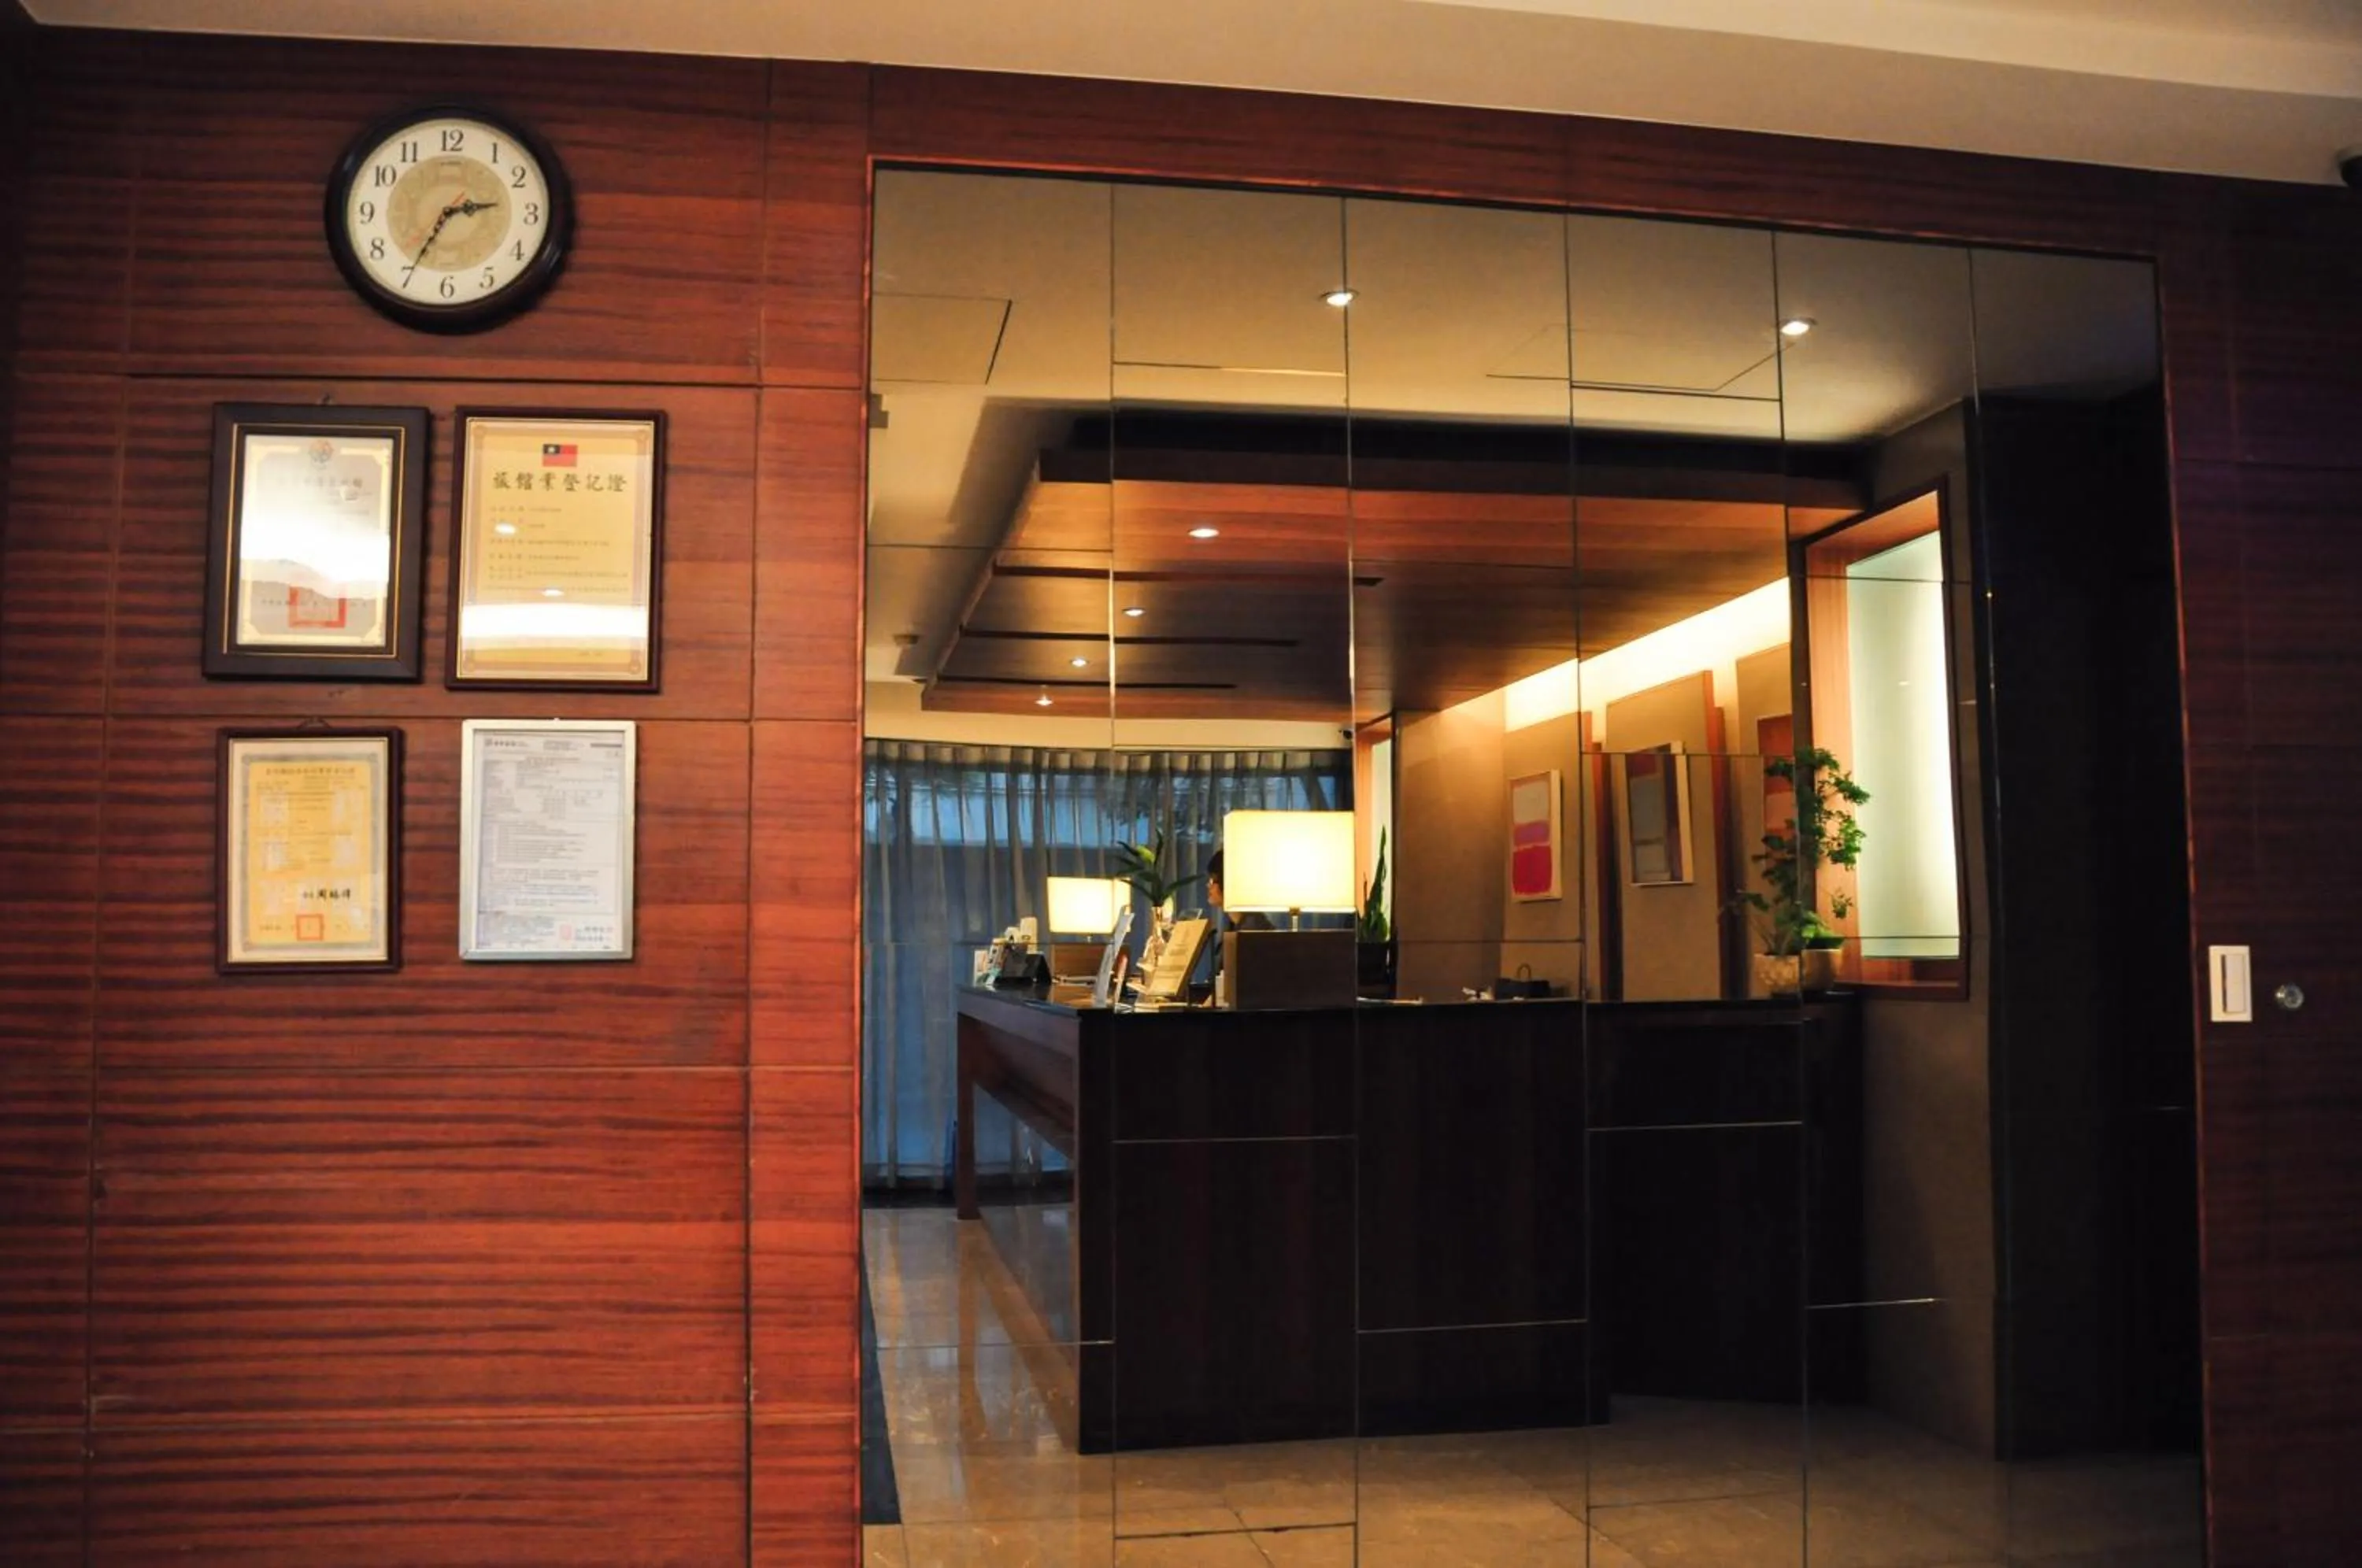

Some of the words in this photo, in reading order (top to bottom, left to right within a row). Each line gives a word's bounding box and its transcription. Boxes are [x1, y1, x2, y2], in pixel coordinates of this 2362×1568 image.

[440, 129, 464, 152] 12
[400, 142, 417, 163] 11
[491, 142, 499, 163] 1
[374, 165, 397, 187] 10
[512, 167, 526, 188] 2
[360, 202, 375, 224] 9
[524, 203, 539, 225] 3
[370, 238, 384, 260] 8
[509, 239, 524, 261] 4
[401, 266, 414, 288] 7
[440, 276, 454, 298] 6
[479, 267, 494, 288] 5
